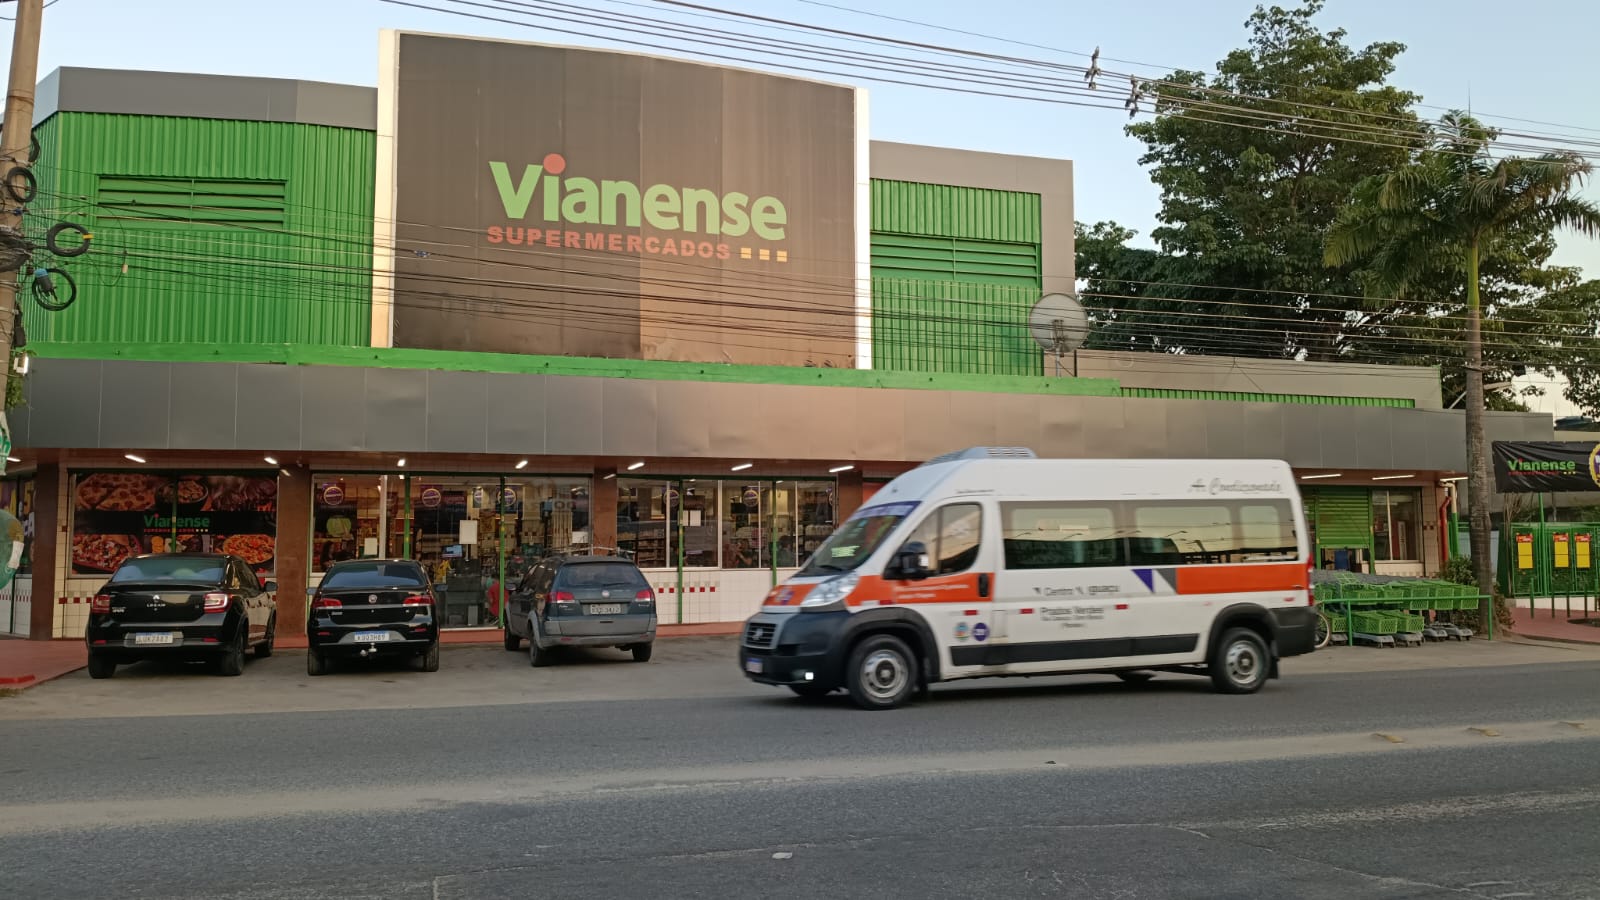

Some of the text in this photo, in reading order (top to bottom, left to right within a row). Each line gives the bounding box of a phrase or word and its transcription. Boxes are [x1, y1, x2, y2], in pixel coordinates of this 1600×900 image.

[489, 153, 787, 240] Vianense
[487, 225, 731, 260] SUPERMERCADOS
[1507, 458, 1576, 471] Vianense
